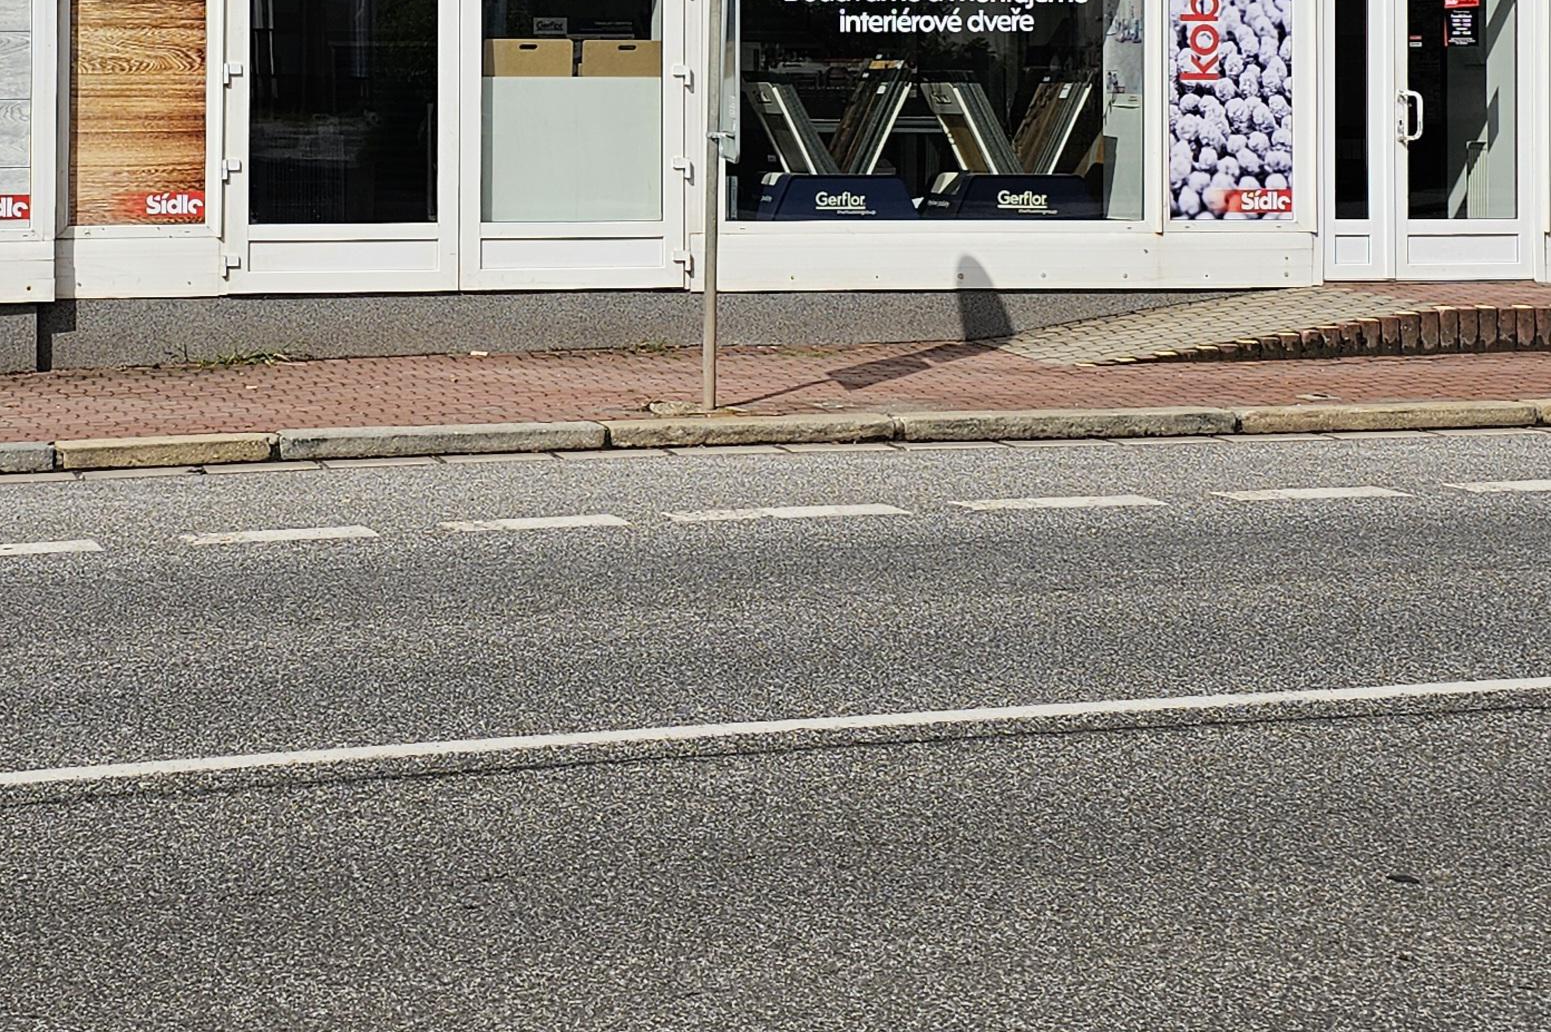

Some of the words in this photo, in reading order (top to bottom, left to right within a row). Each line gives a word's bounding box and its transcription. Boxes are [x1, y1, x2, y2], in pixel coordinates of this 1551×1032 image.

[839, 7, 962, 33] interiérové
[967, 8, 1035, 33] dveře
[815, 191, 866, 207] Gerflor
[997, 189, 1048, 207] Gerflor
